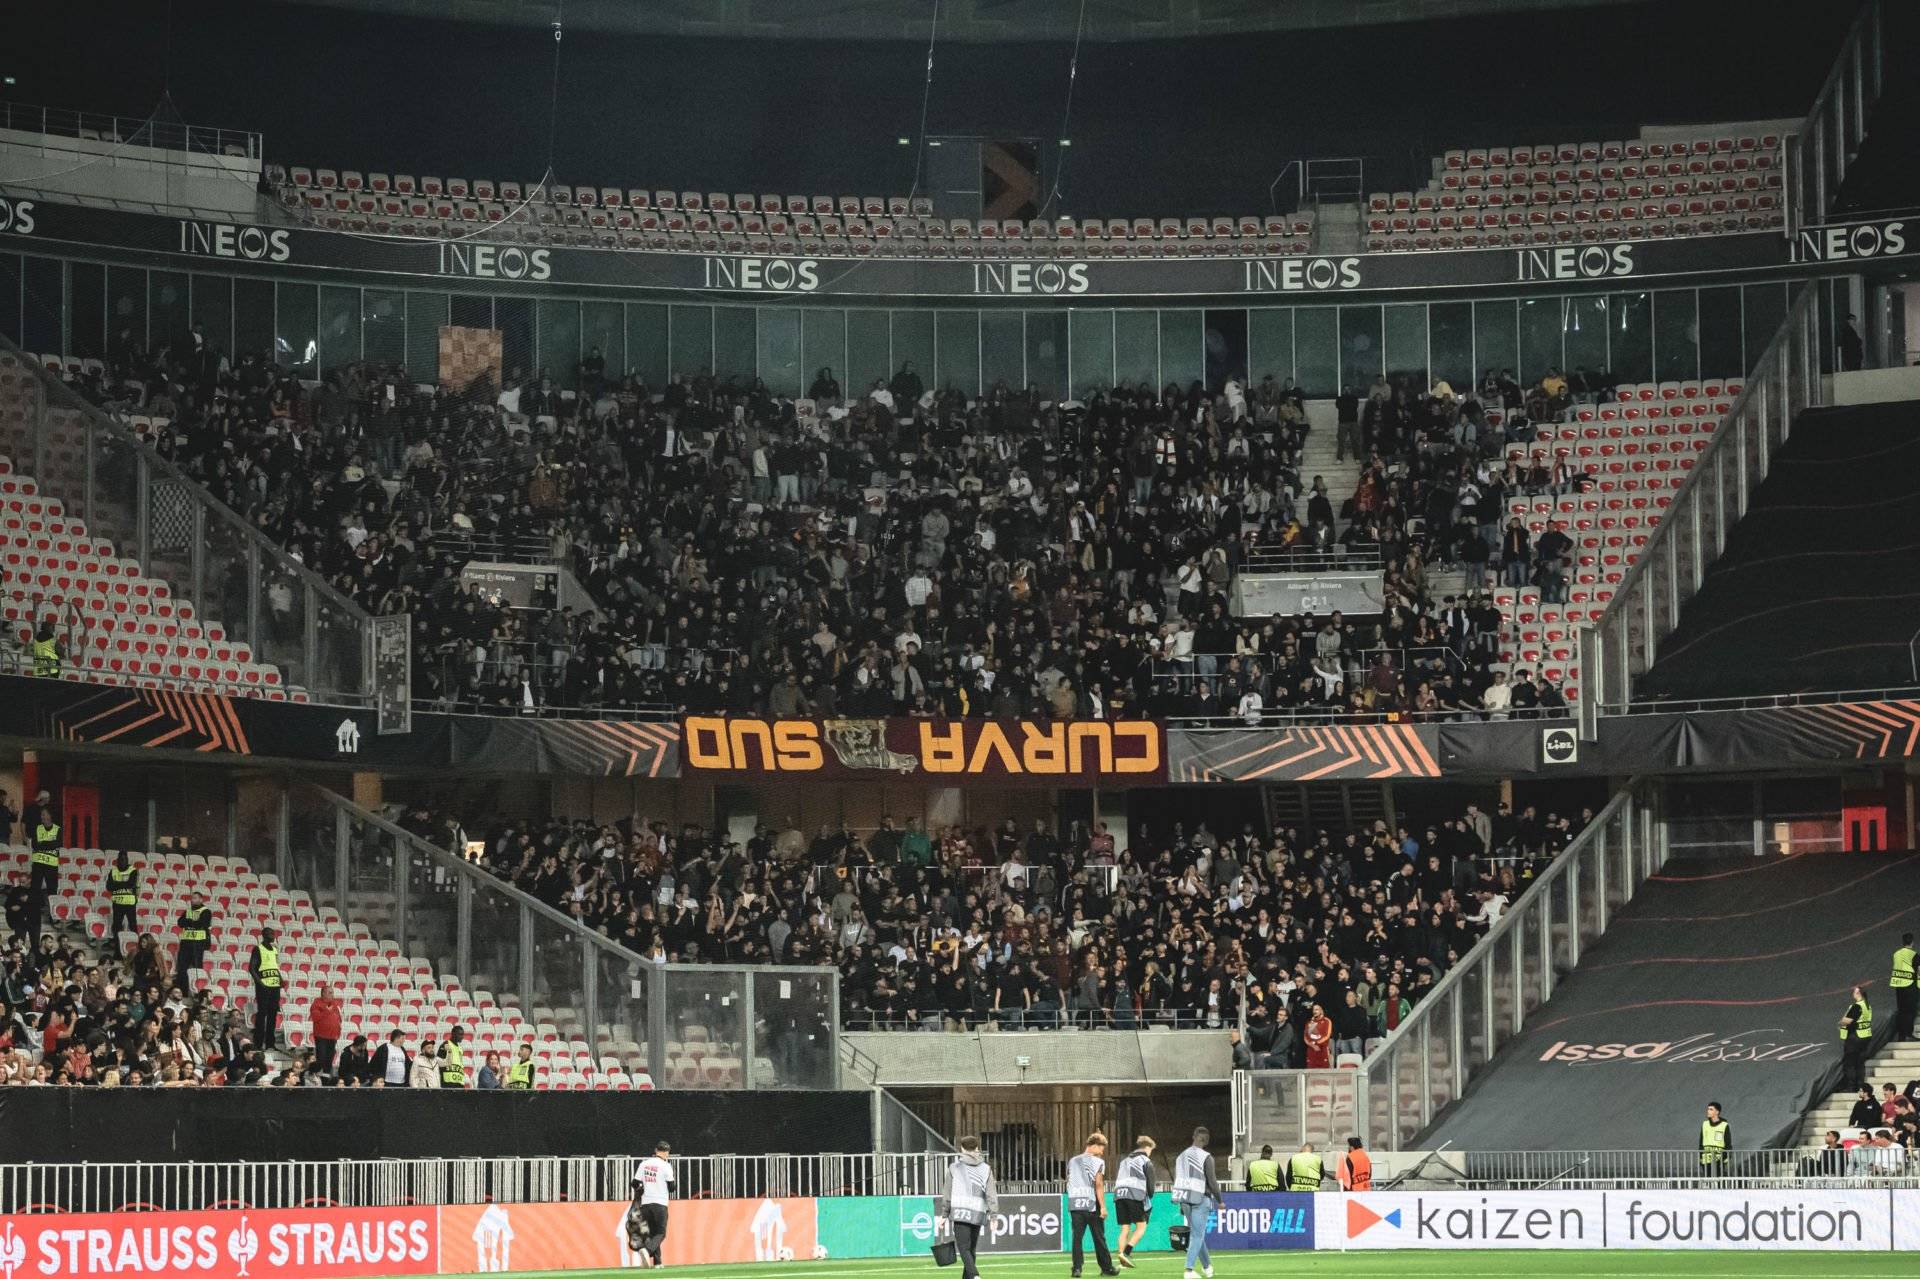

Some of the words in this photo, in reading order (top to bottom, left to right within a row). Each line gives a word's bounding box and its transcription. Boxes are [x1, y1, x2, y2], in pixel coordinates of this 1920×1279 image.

[180, 221, 290, 261] INEOS
[1789, 222, 1905, 263] INEOS
[438, 243, 550, 280] INEOS
[704, 257, 819, 292] INEOS
[973, 263, 1089, 294] INEOS
[1244, 257, 1361, 291] INEOS
[1517, 243, 1634, 281] INEOS
[685, 716, 824, 771] SUD
[919, 721, 1159, 774] CURVA
[1539, 1041, 1671, 1062] Issa
[902, 1205, 1060, 1244] enprise
[954, 1209, 972, 1221] 273
[1206, 1208, 1306, 1234] #FOOTBALL
[1417, 1198, 1584, 1240] kaizen
[1626, 1200, 1863, 1242] foundation
[37, 1224, 218, 1274] STRAUSS
[269, 1220, 428, 1267] STRAUSS
